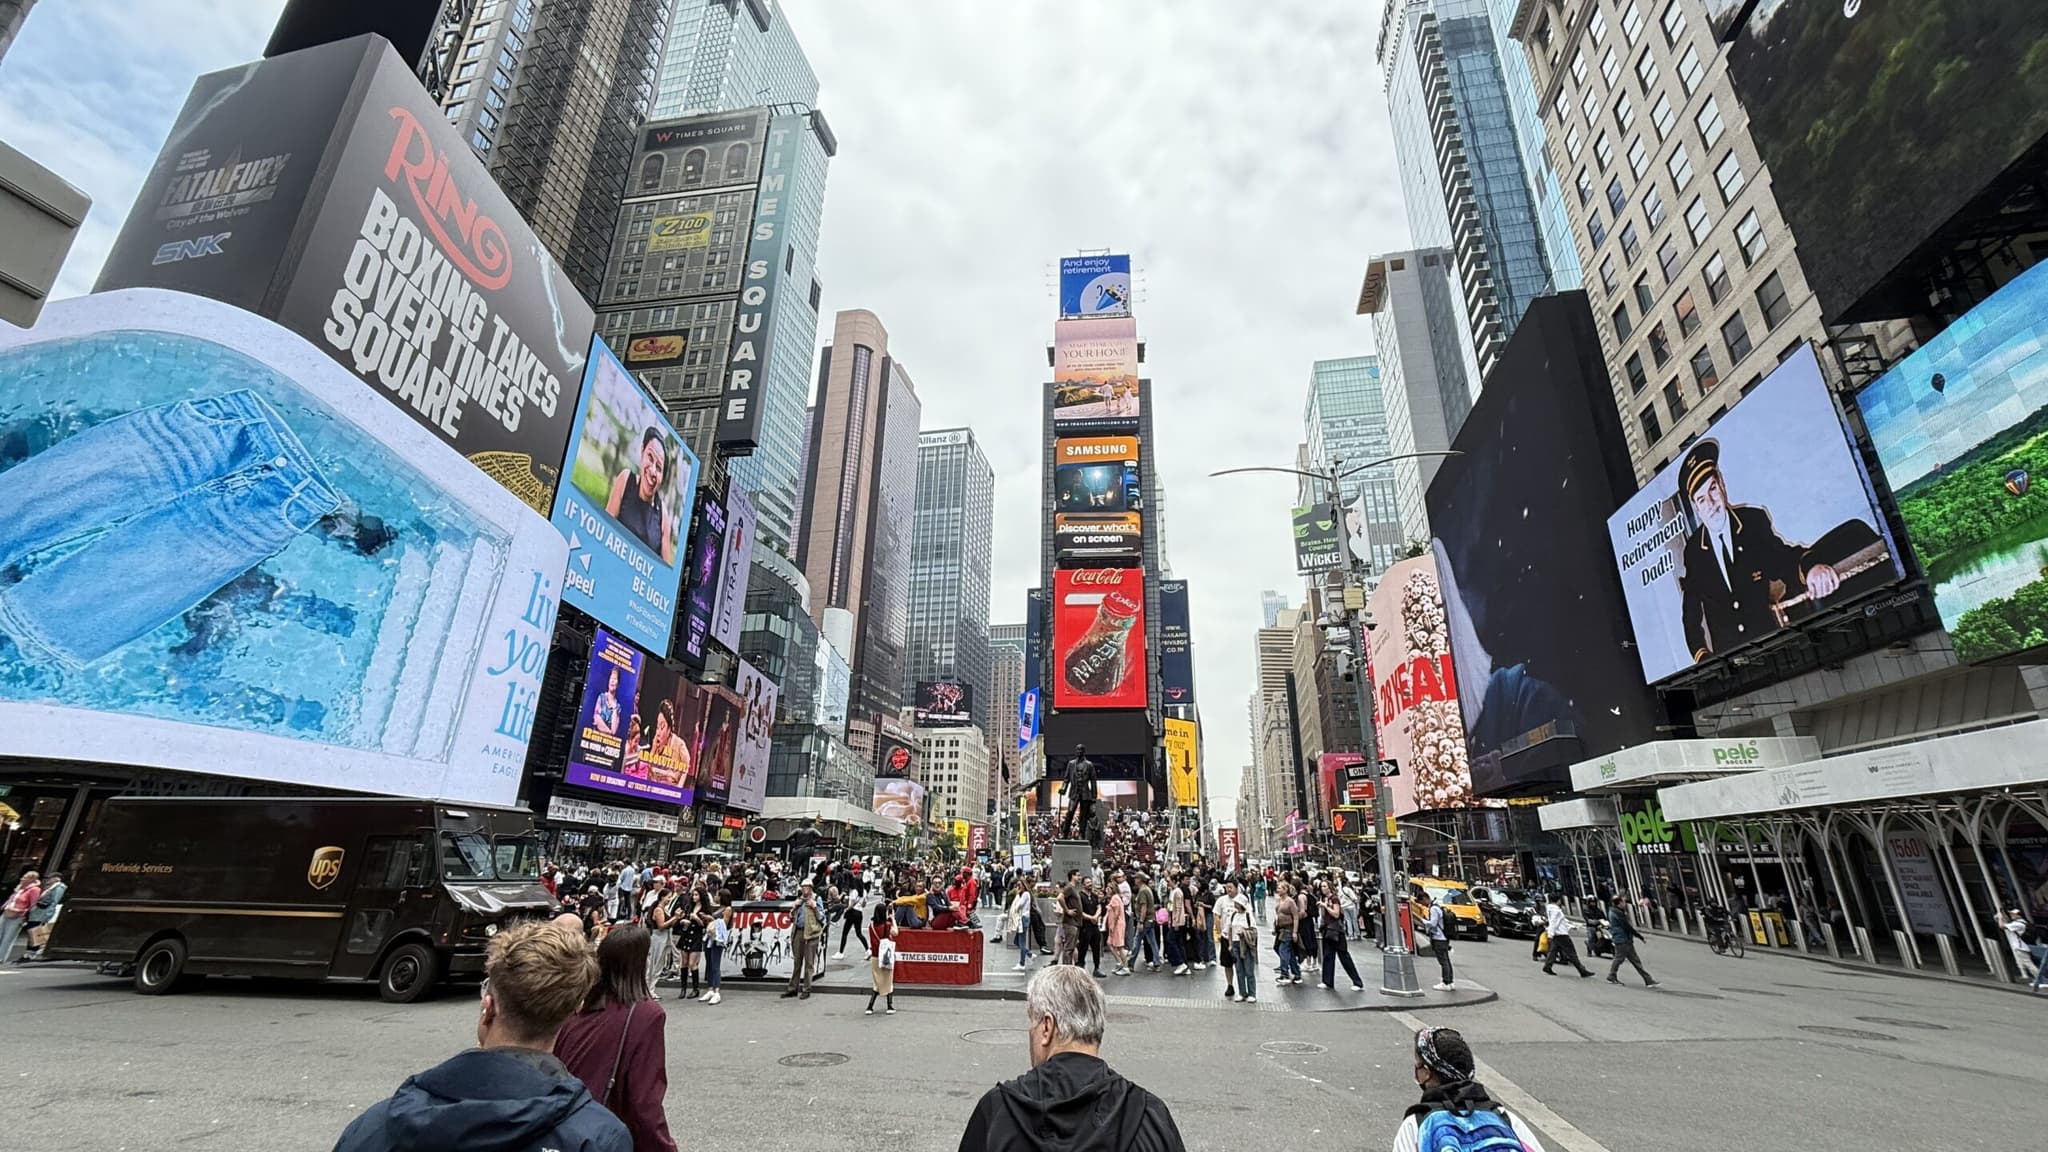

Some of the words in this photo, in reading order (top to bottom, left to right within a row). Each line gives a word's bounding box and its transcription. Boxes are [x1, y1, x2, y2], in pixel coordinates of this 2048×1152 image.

[657, 131, 673, 143] W
[675, 130, 703, 139] TIMES
[707, 124, 746, 135] SQUARE
[160, 167, 226, 207] FATAL
[224, 153, 291, 193] FURY
[754, 128, 790, 241] TIMES
[660, 217, 705, 235] Z100
[152, 232, 232, 265] SNK
[1064, 258, 1082, 267] And
[1084, 257, 1110, 267] enjoy
[1064, 265, 1112, 275] retirement
[360, 187, 487, 342] BOXING
[487, 315, 560, 419] TAKES
[343, 239, 442, 359] OVER
[442, 329, 525, 433] TIMES
[727, 260, 768, 421] SQUARE
[323, 288, 468, 439] SQUARE
[1066, 445, 1127, 455] SAMSUNG
[1059, 523, 1101, 532] Discover
[1103, 523, 1137, 532] what's
[1626, 499, 1662, 538] Happy
[563, 497, 579, 520] IF
[579, 508, 606, 542] YOU
[604, 531, 628, 561] ARE
[628, 549, 655, 582] UGLY.
[1088, 535, 1123, 543] screen
[1621, 513, 1683, 571] Retirement
[1641, 551, 1674, 586] Dad!!
[566, 568, 596, 598] peel
[632, 575, 646, 597] BE
[646, 588, 671, 615] UGLY.
[721, 561, 738, 634] ULTRA
[1380, 682, 1395, 726] 28
[1353, 767, 1368, 777] ONE
[1223, 831, 1236, 855] tkts
[1636, 843, 1671, 854] SOCCER
[101, 862, 140, 873] Worldwide
[141, 863, 173, 873] Services
[310, 858, 340, 883] ups
[732, 911, 793, 930] HICAG
[901, 953, 926, 961] TIMES
[927, 954, 959, 962] SQUARE
